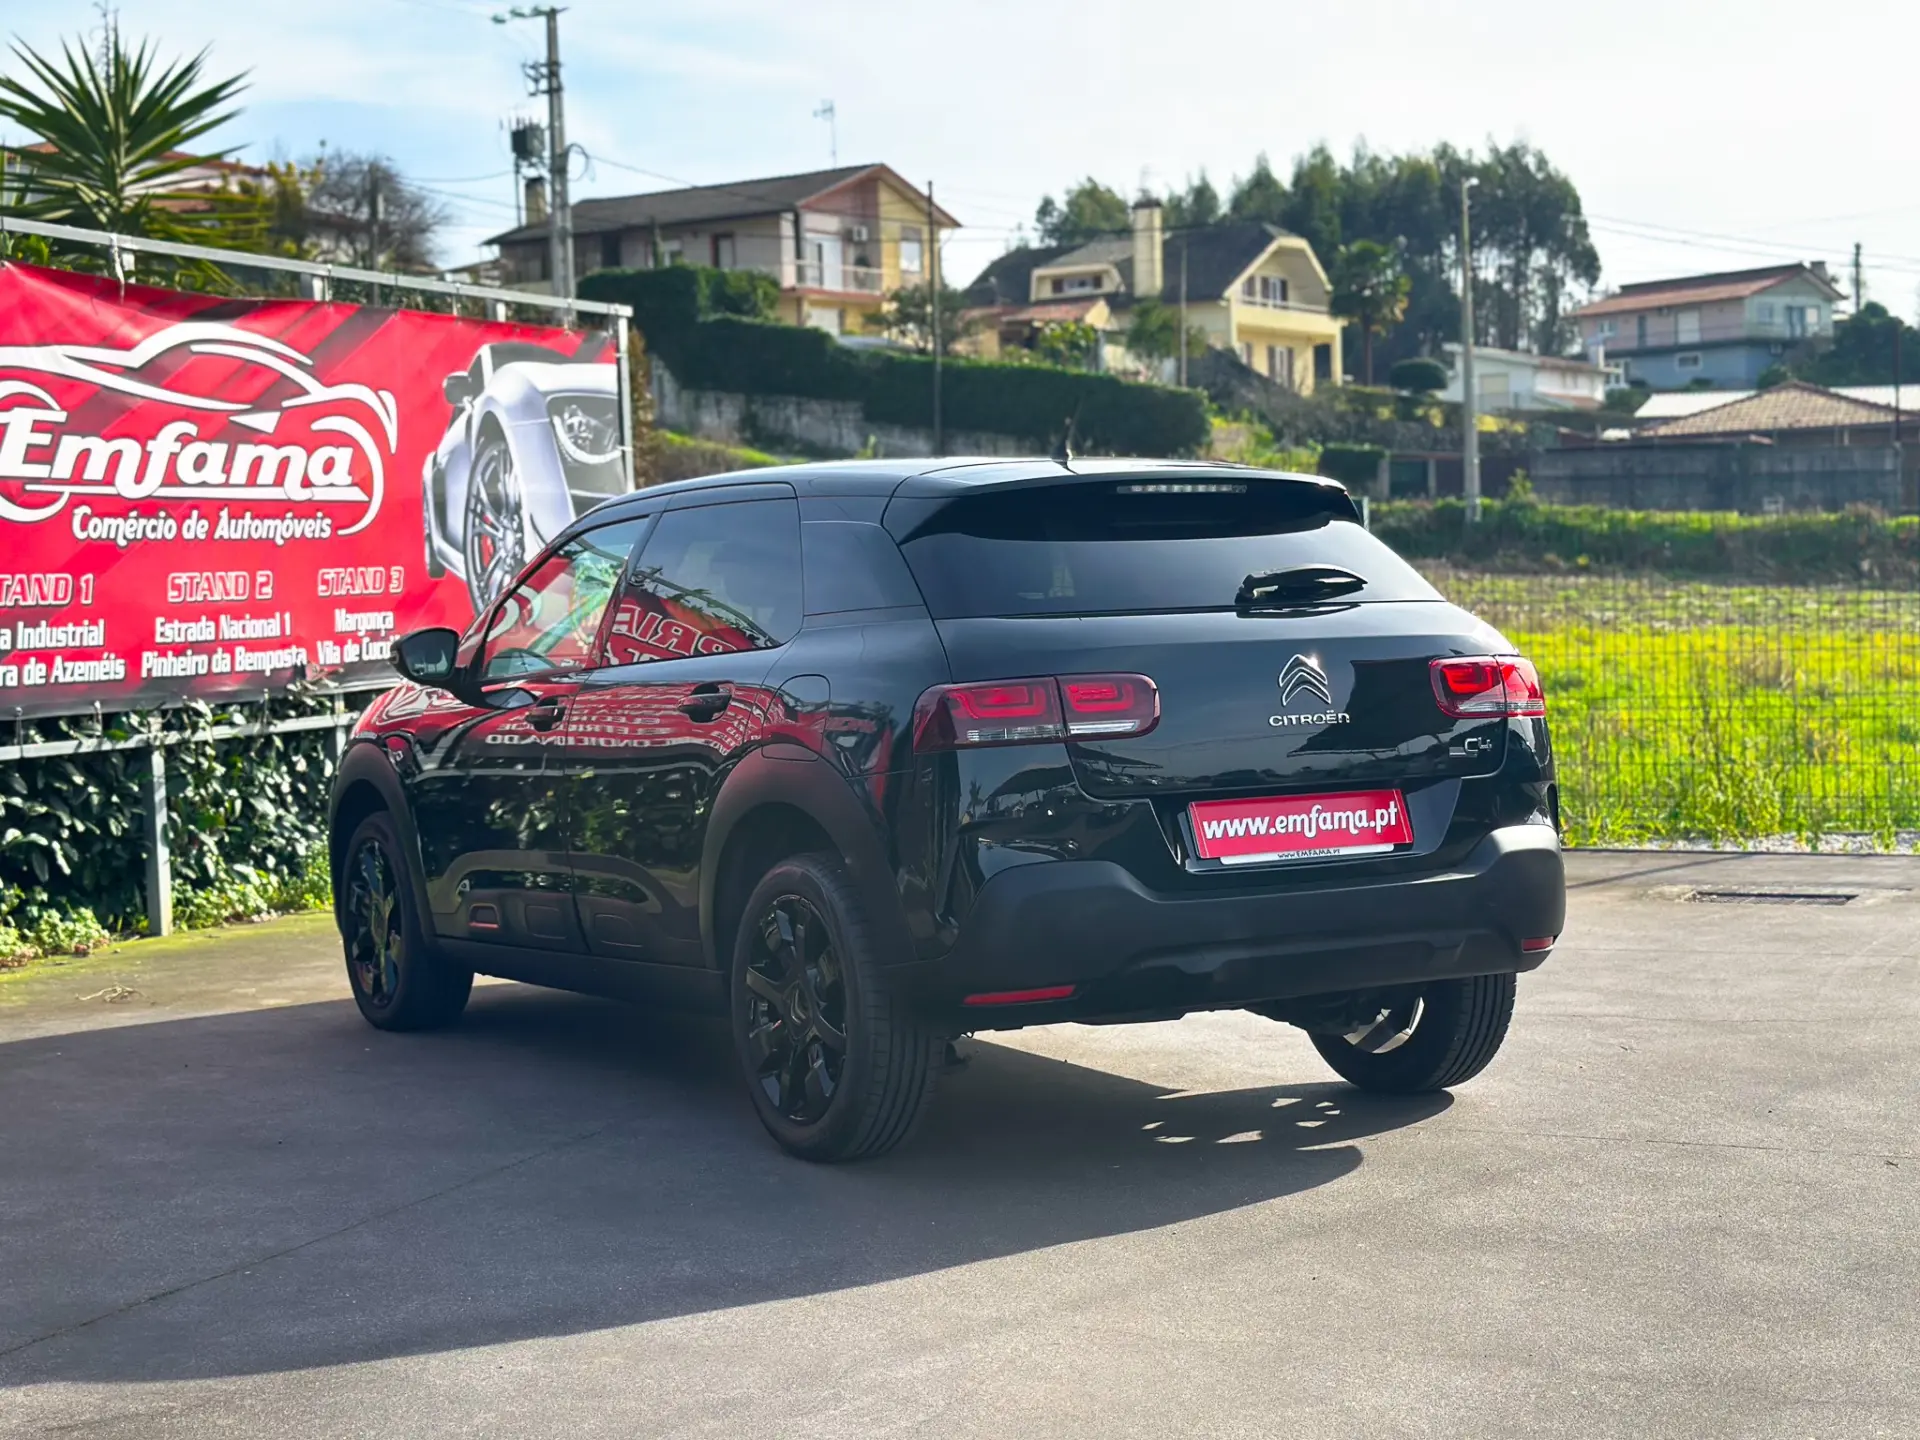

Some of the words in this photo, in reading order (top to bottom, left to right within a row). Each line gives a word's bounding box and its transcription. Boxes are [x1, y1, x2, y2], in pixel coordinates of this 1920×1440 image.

[0, 407, 354, 500] Emfama
[72, 505, 177, 547] Comércio
[181, 509, 209, 540] de
[213, 507, 332, 546] Automóveis
[80, 573, 94, 605] 1
[167, 571, 250, 603] STAND
[255, 570, 273, 600] 2
[317, 567, 386, 597] STAND
[389, 565, 405, 594] 3
[17, 619, 105, 650] Industrial
[155, 615, 216, 644] Estrada
[219, 611, 281, 641] Nacional
[283, 611, 291, 636] 1
[334, 608, 394, 637] Margonça
[141, 649, 208, 679] Pinheiro
[211, 647, 232, 674] da
[235, 645, 307, 677] Bemposta
[317, 639, 341, 665] Vila
[343, 639, 360, 662] de
[22, 656, 47, 685] de
[50, 652, 126, 684] Azeméis
[1268, 709, 1350, 727] CITROËN
[1464, 736, 1493, 752] C4
[1202, 800, 1398, 840] www.emfama.pt
